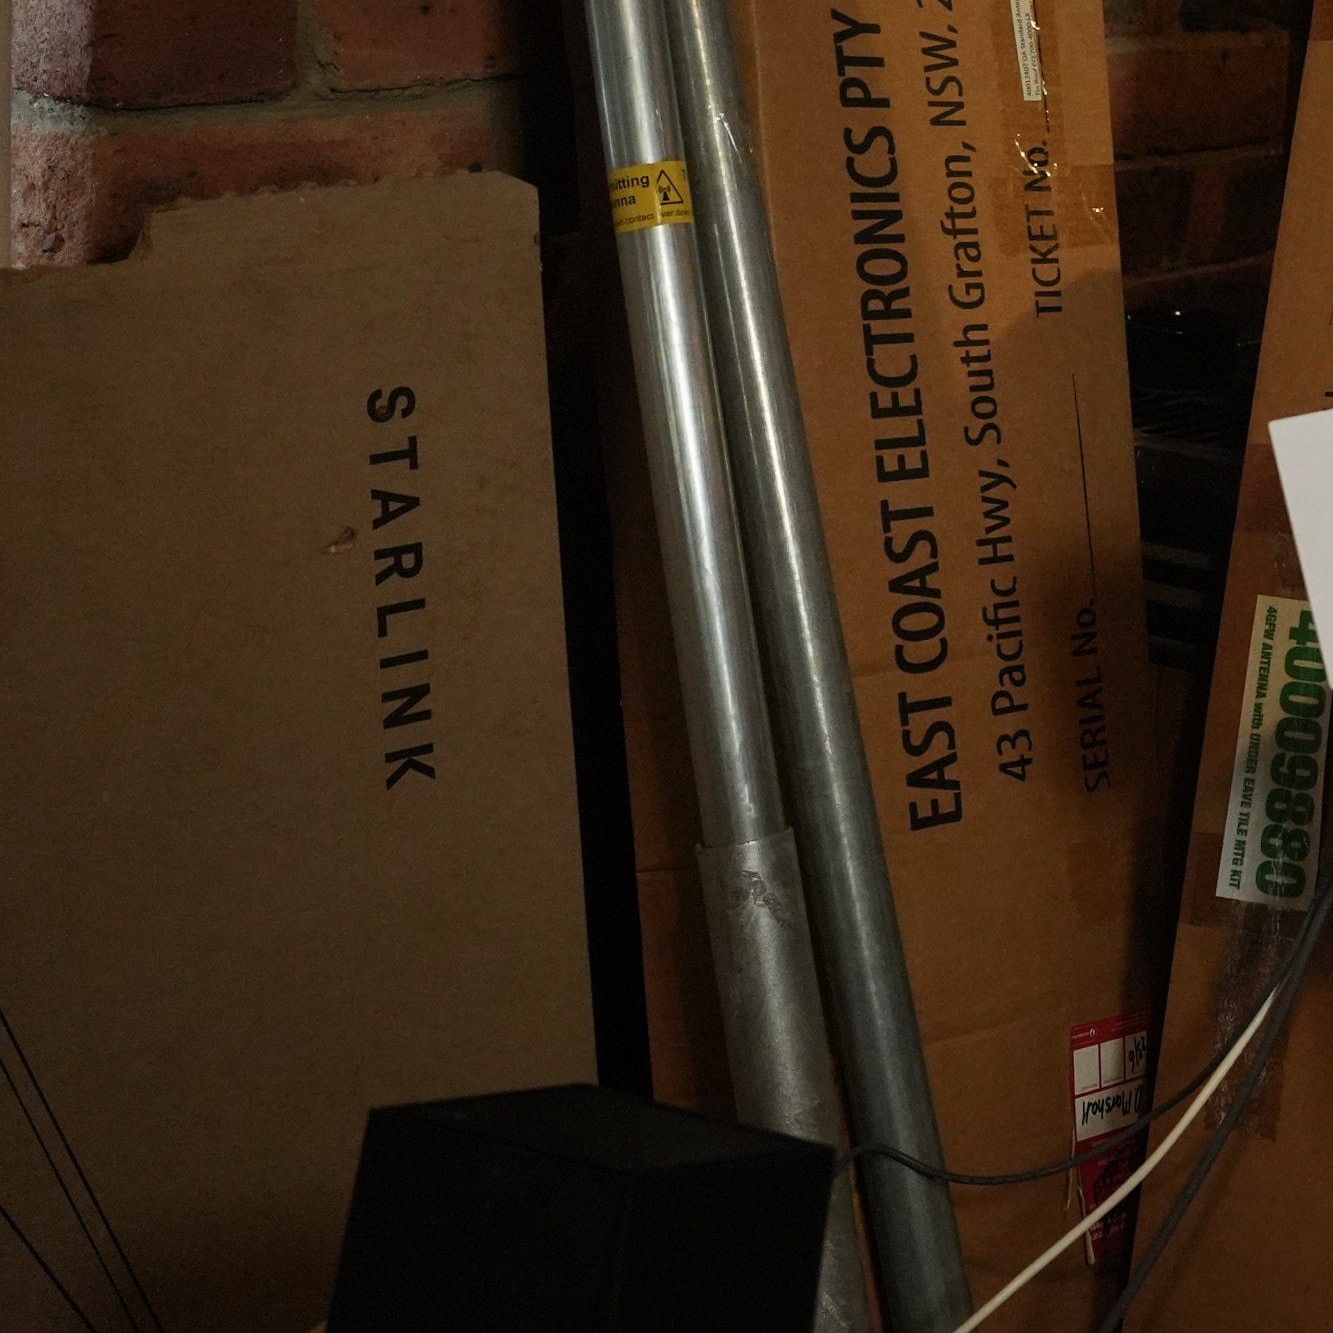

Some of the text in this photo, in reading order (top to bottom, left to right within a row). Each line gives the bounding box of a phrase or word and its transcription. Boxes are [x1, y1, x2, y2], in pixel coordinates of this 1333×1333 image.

[830, 10, 891, 108] PTY
[919, 24, 967, 127] NSW,
[1018, 19, 1026, 50] Standard
[940, 141, 986, 309] Grafton,
[1025, 204, 1063, 318] TICKET
[843, 126, 930, 483] ELECTRONICS
[953, 321, 1003, 447] South
[977, 458, 1018, 566] Hwy,
[366, 385, 437, 791] STARLINK
[880, 500, 948, 673] COAST
[982, 576, 1029, 715] Pacific
[1072, 598, 1111, 793] SERIAL No.
[1255, 642, 1275, 699] ANTENNA
[895, 691, 962, 831] EAST
[993, 729, 1033, 782] 43
[1245, 733, 1262, 774] UNDER
[1251, 702, 1266, 730] with
[1255, 608, 1326, 899] 40009880
[1236, 811, 1251, 836] TILE
[1240, 777, 1256, 808] EAVE
[1228, 869, 1242, 890] KIT
[1231, 839, 1247, 866] MTG
[1081, 1089, 1133, 1127] Marshall
